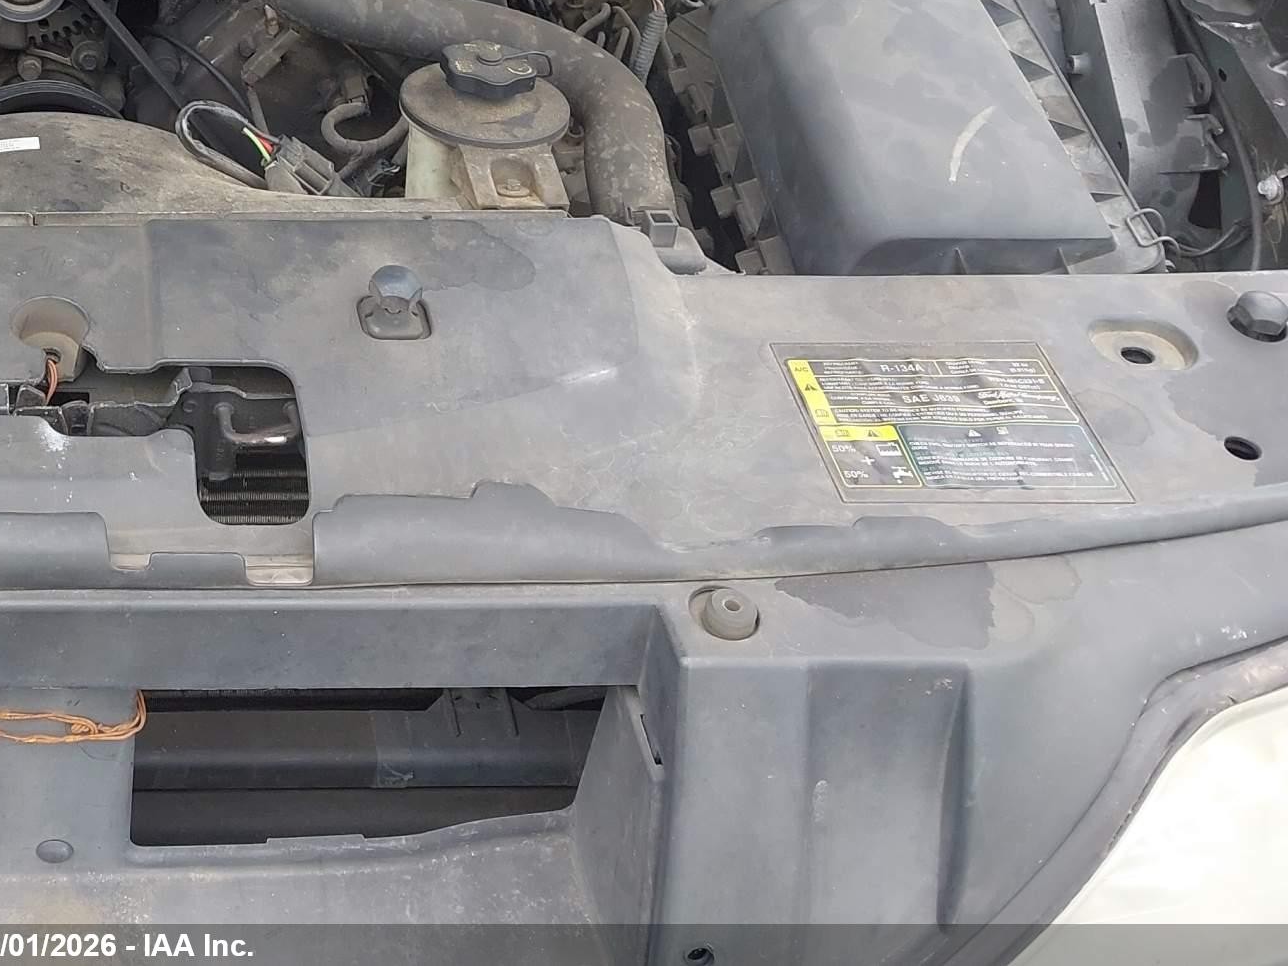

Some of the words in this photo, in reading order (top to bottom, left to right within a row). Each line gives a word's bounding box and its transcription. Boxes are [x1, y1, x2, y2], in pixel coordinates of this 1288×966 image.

[880, 364, 926, 373] R-134A
[902, 394, 930, 404] SAE
[831, 443, 857, 453] 50%
[843, 469, 869, 479] 50%
